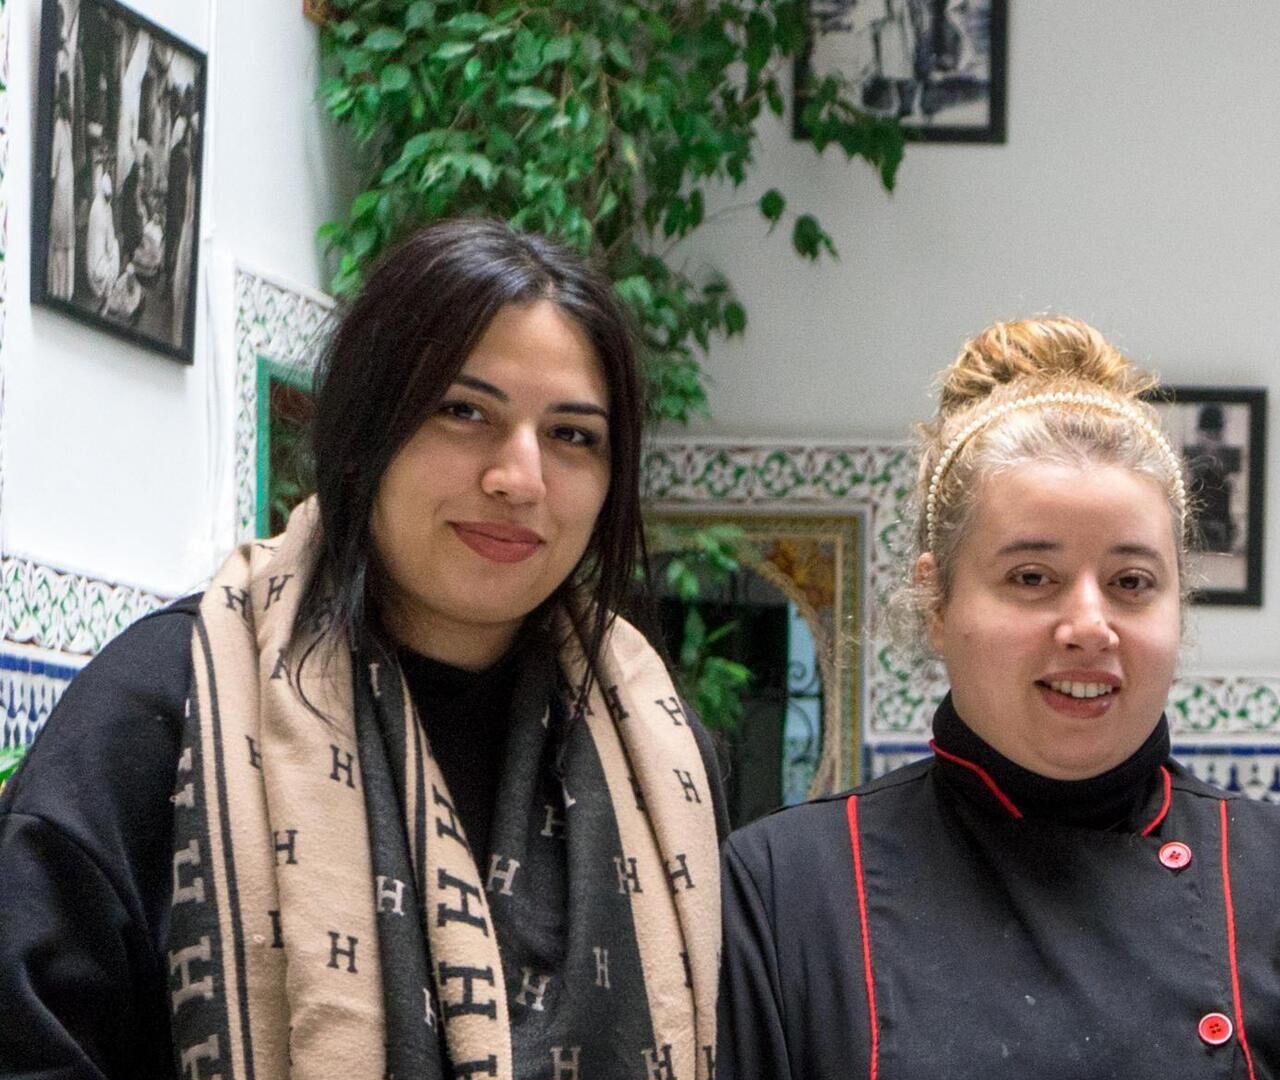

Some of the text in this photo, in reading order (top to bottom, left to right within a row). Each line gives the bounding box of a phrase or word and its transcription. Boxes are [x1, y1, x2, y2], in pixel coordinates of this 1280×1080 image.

[264, 574, 294, 611] H
[330, 744, 355, 789] H
[673, 769, 702, 804] H
[376, 875, 405, 916] H
[485, 854, 520, 896] H
[613, 856, 643, 895] H
[327, 931, 358, 974] H
[593, 946, 611, 989] H
[515, 966, 551, 1012] H
